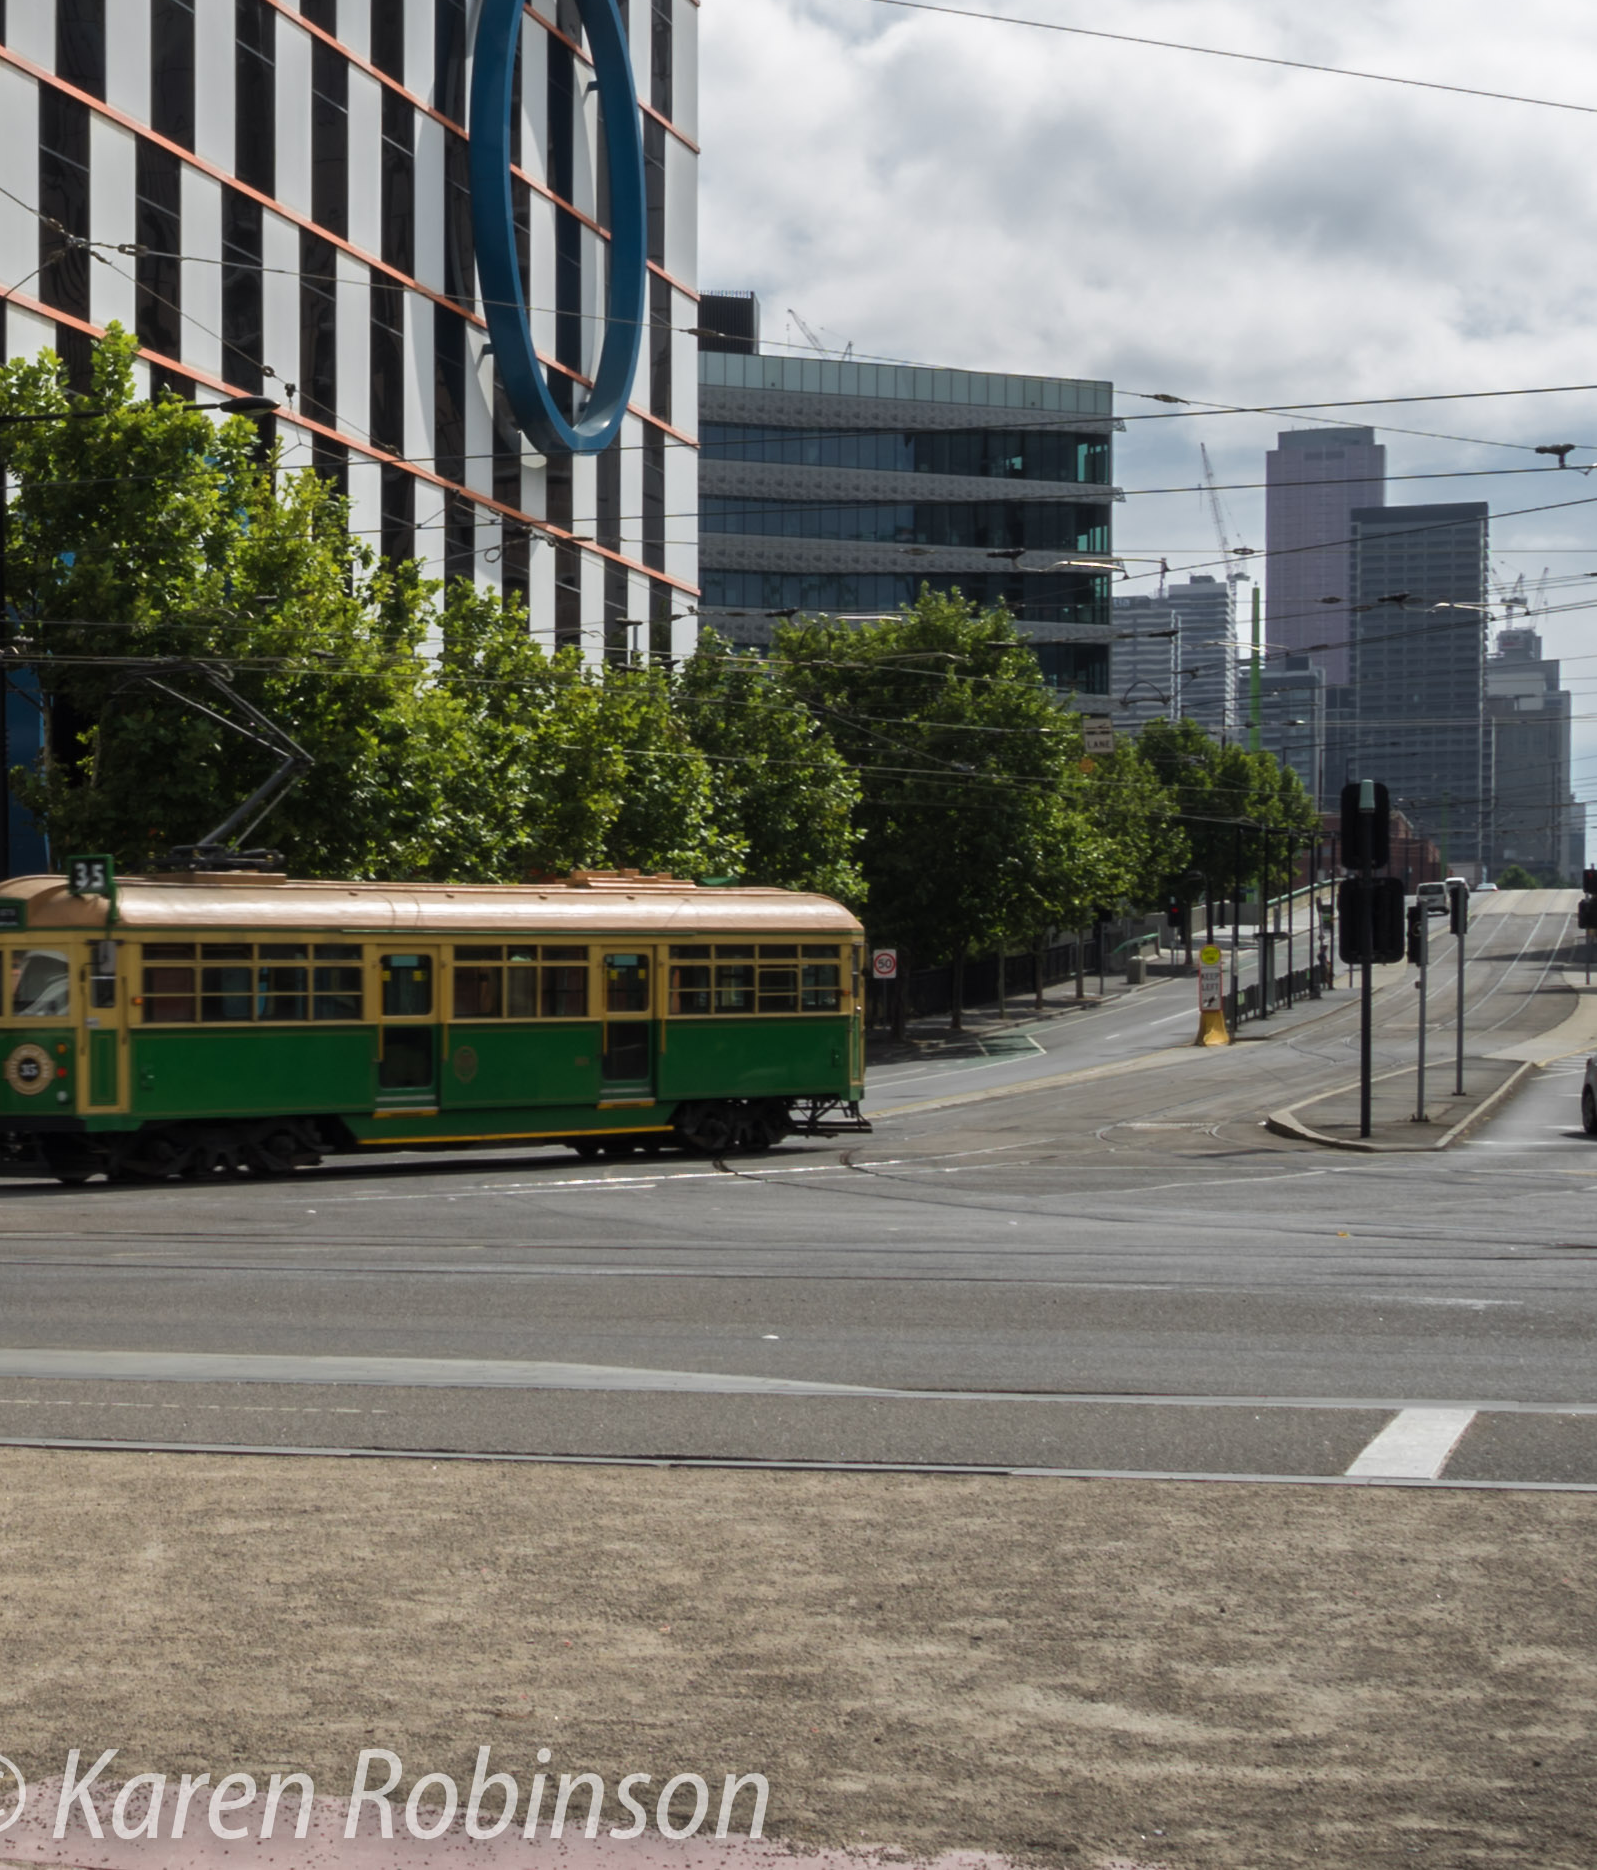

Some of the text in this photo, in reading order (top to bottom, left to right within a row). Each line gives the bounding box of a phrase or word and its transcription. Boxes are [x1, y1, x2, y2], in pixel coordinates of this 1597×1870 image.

[1087, 740, 1111, 748] LANE
[75, 862, 105, 887] 35
[878, 959, 892, 969] 50
[1202, 983, 1219, 991] LEFT
[20, 1063, 39, 1077] 35
